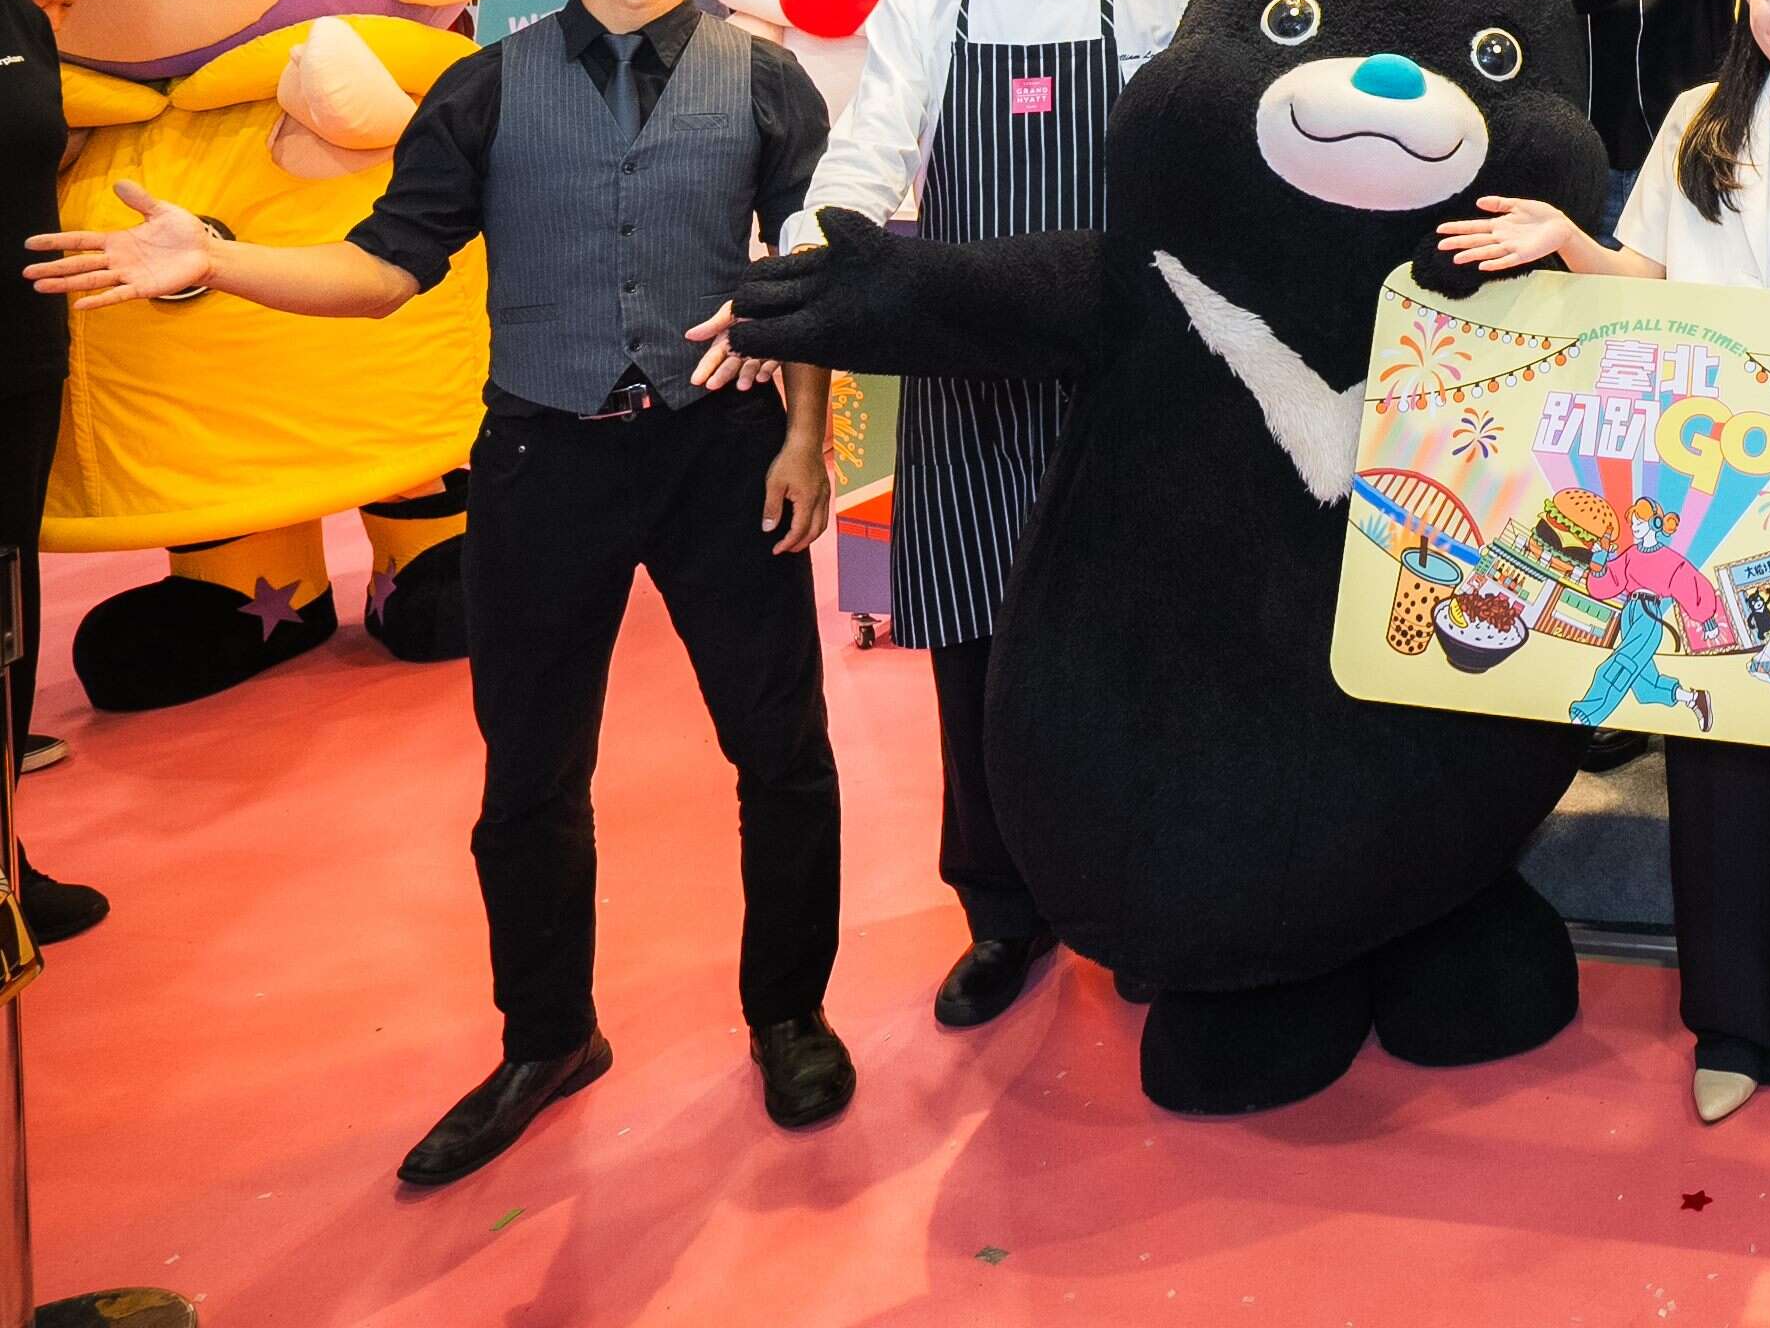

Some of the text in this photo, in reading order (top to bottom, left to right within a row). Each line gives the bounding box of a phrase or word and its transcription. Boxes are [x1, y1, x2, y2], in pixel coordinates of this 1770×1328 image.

[1577, 319, 1749, 358] PARTY ALL THE TIME!
[1595, 339, 1721, 400] 臺北
